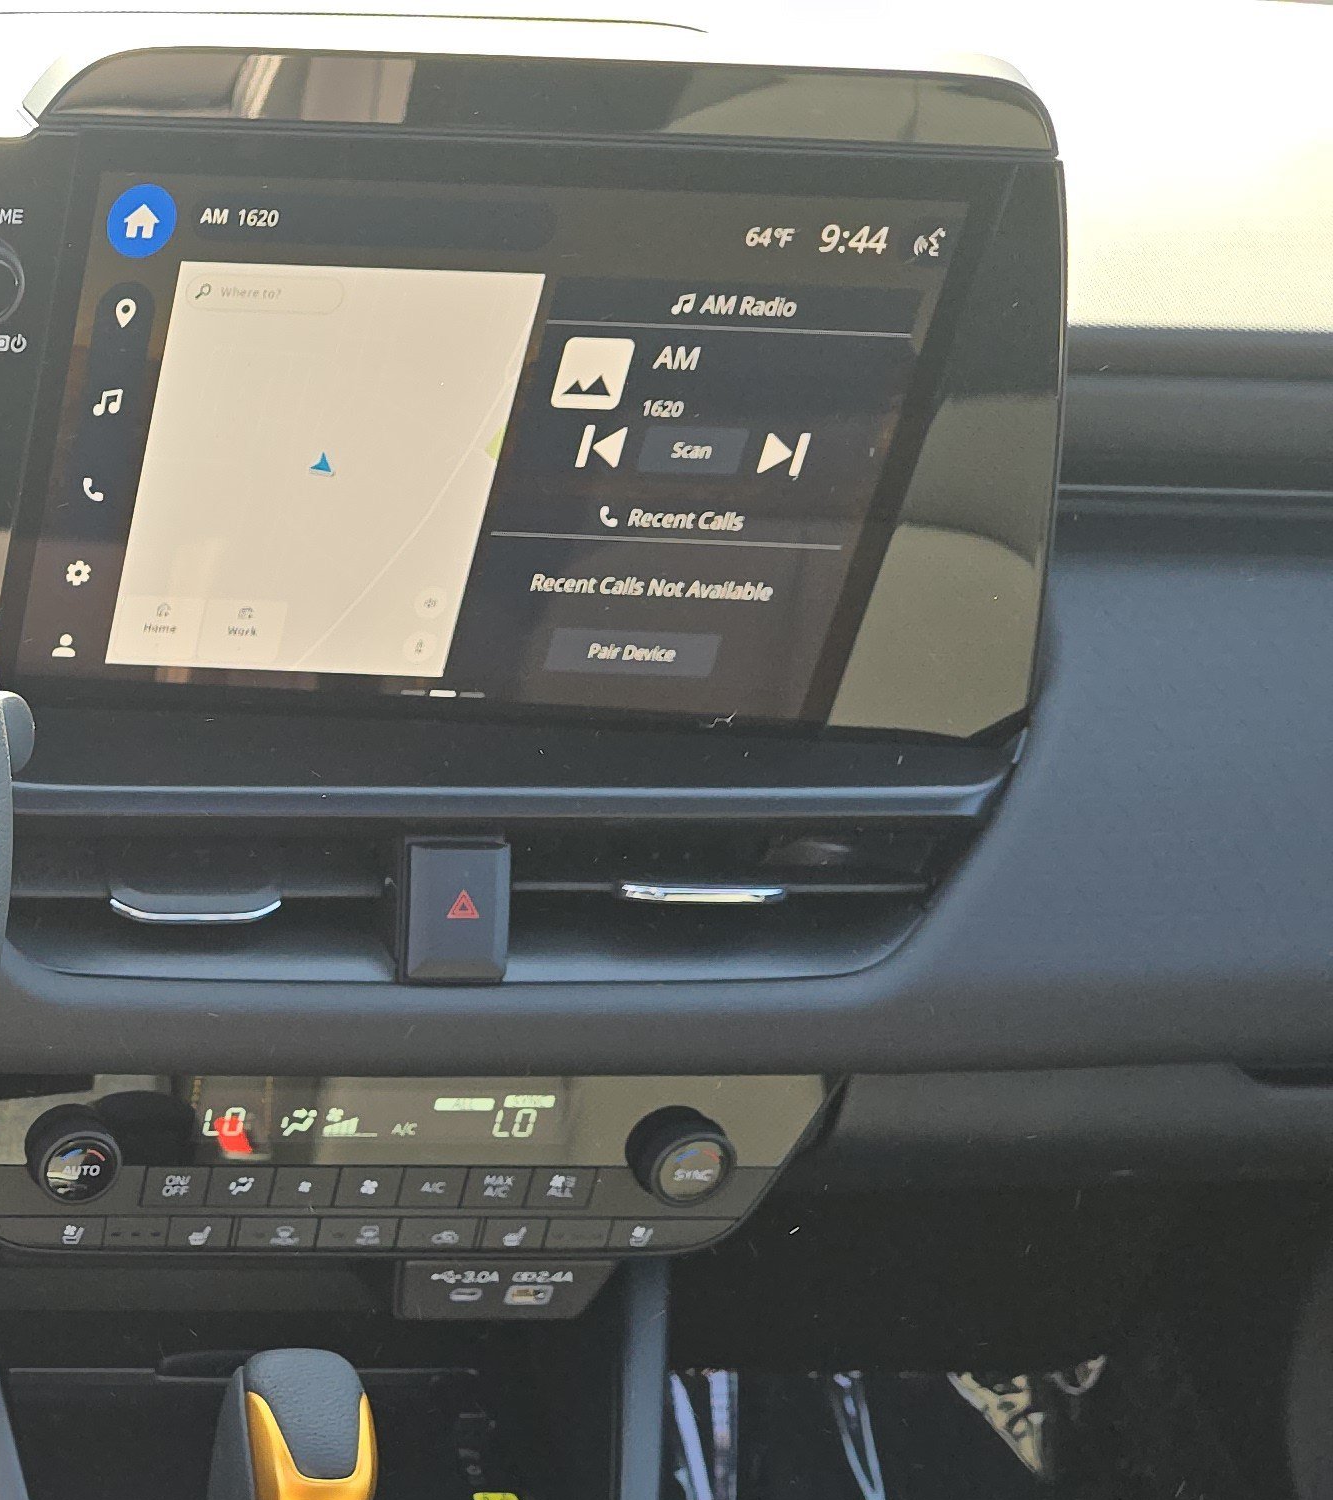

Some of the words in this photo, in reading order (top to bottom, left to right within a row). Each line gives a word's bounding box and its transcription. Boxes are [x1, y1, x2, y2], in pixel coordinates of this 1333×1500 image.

[200, 208, 229, 226] AM
[237, 208, 280, 228] 1620
[818, 224, 890, 255] 9:44
[220, 286, 259, 298] Where
[262, 287, 282, 300] to?
[699, 294, 737, 315] AM
[738, 296, 798, 318] Radio
[653, 346, 702, 371] AM
[642, 399, 685, 418] 1620
[670, 442, 713, 461] Scan
[627, 508, 693, 531] Recent
[696, 510, 745, 532] Calls
[530, 573, 595, 595] Recent
[598, 575, 644, 597] Calls
[647, 577, 686, 599] Not
[688, 579, 775, 602] Available
[587, 643, 620, 662] Pair
[624, 644, 678, 664] Device
[391, 1121, 418, 1136] A/C
[62, 1164, 101, 1177] AUTO
[674, 1168, 713, 1182] SYNC
[420, 1181, 447, 1194] A/C
[483, 1174, 515, 1187] MAX
[162, 1185, 190, 1197] OFF
[483, 1186, 510, 1198] A/C
